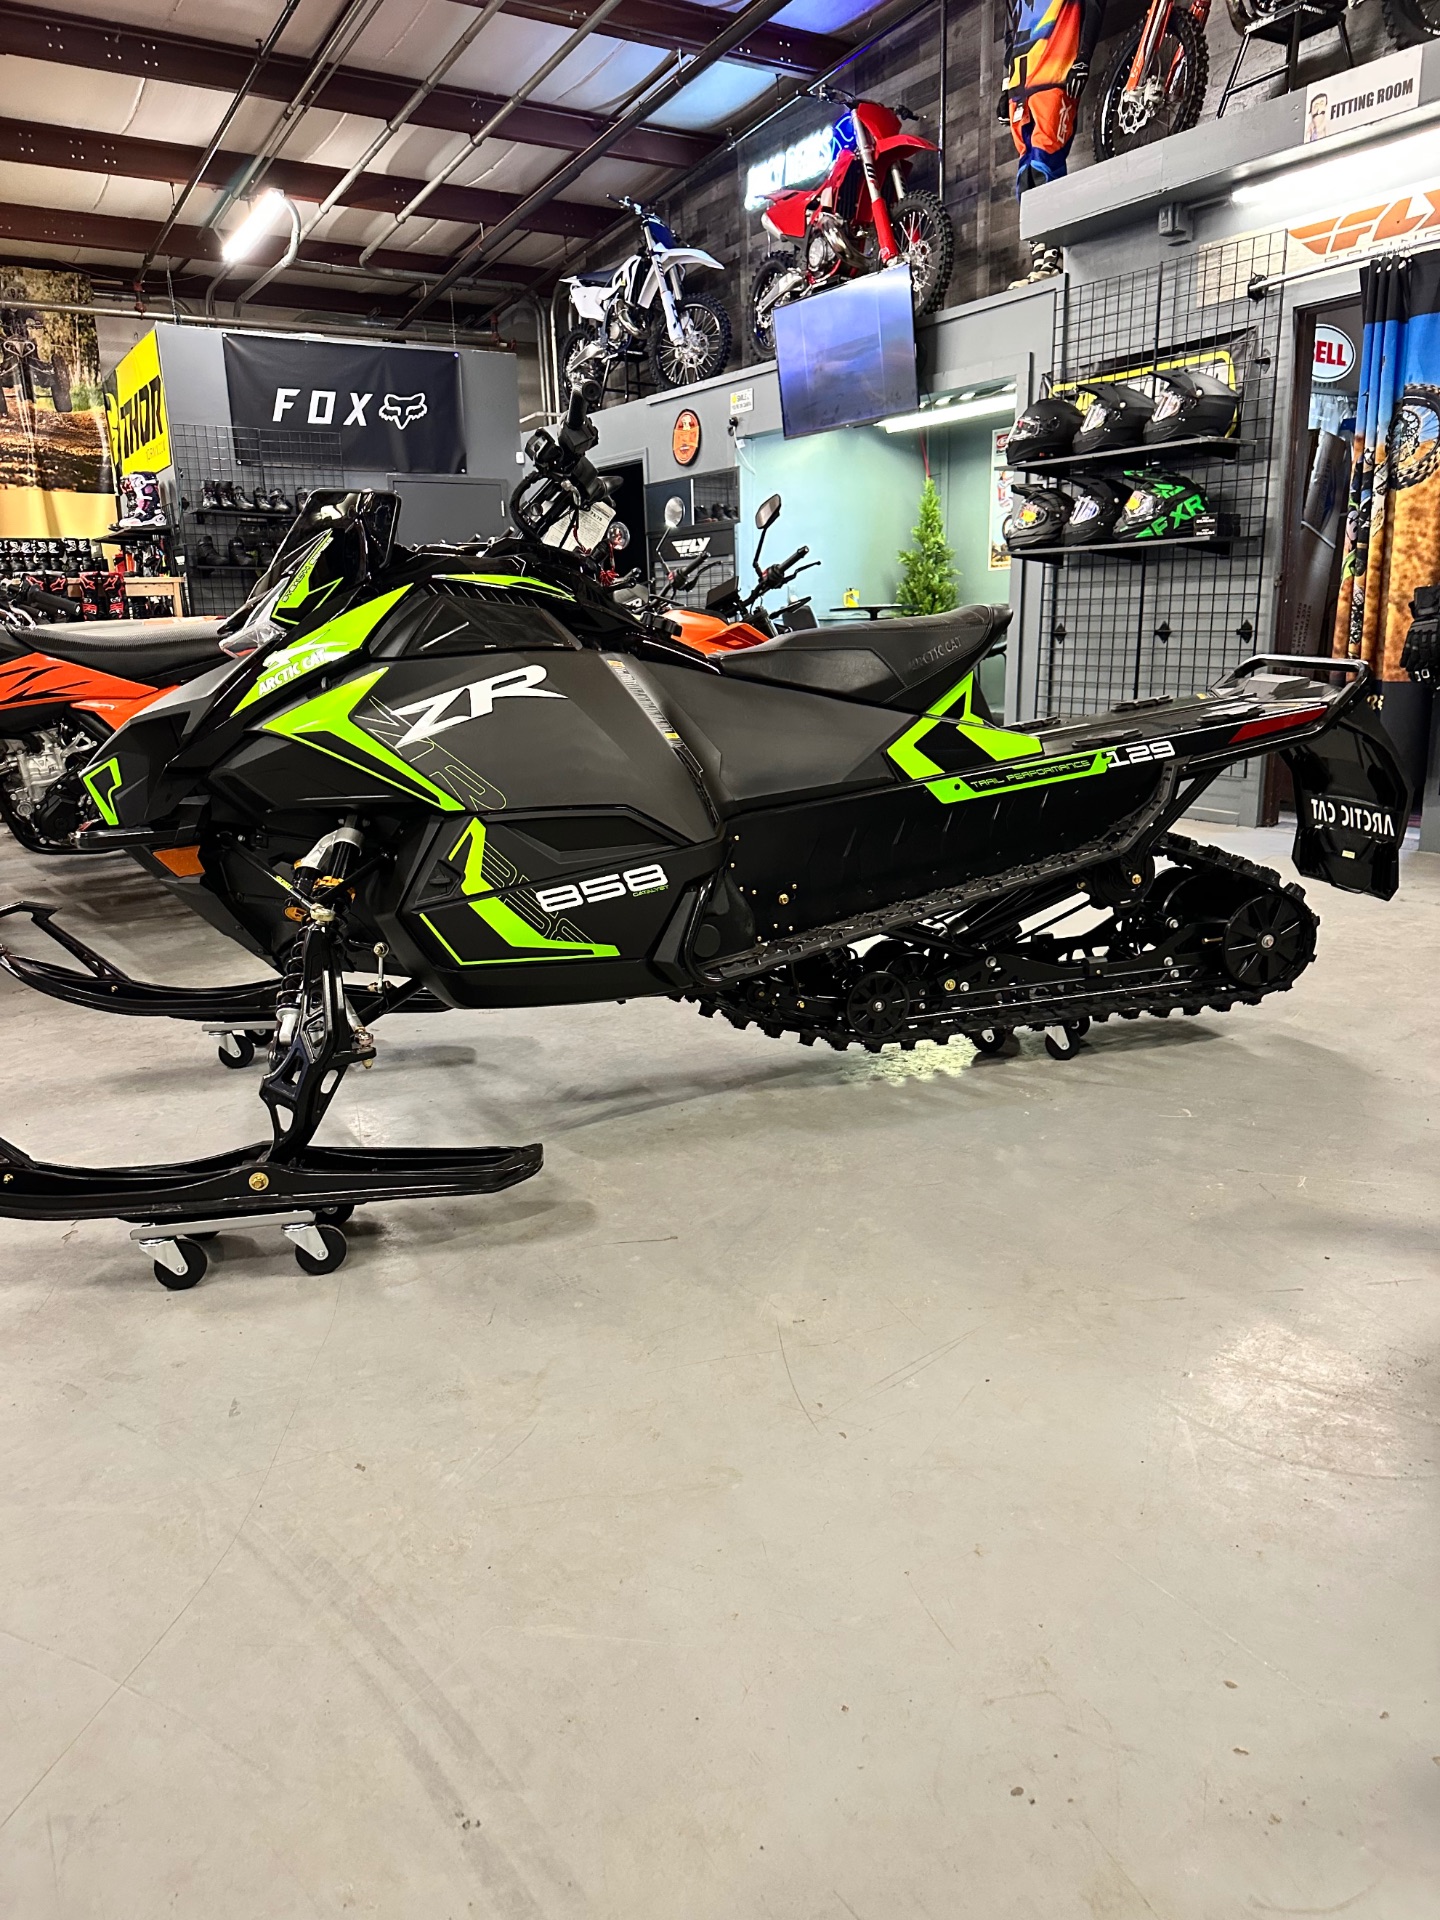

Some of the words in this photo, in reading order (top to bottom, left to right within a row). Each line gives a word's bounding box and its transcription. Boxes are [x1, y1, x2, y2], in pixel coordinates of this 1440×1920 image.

[1330, 92, 1375, 120] FITTING
[1377, 77, 1413, 105] ROOM
[1312, 340, 1347, 366] ELL
[120, 375, 163, 459] THOR
[272, 388, 373, 427] FOX
[1150, 494, 1205, 536] FXR
[671, 537, 711, 554] FLY
[944, 636, 962, 652] CAT
[258, 662, 301, 696] ARCTIC
[302, 647, 326, 669] CAT
[390, 664, 569, 749] ZR
[970, 778, 1005, 789] TRAIL
[1007, 759, 1090, 781] PERFORMANCE
[1106, 740, 1176, 768] 129
[535, 863, 668, 913] 858
